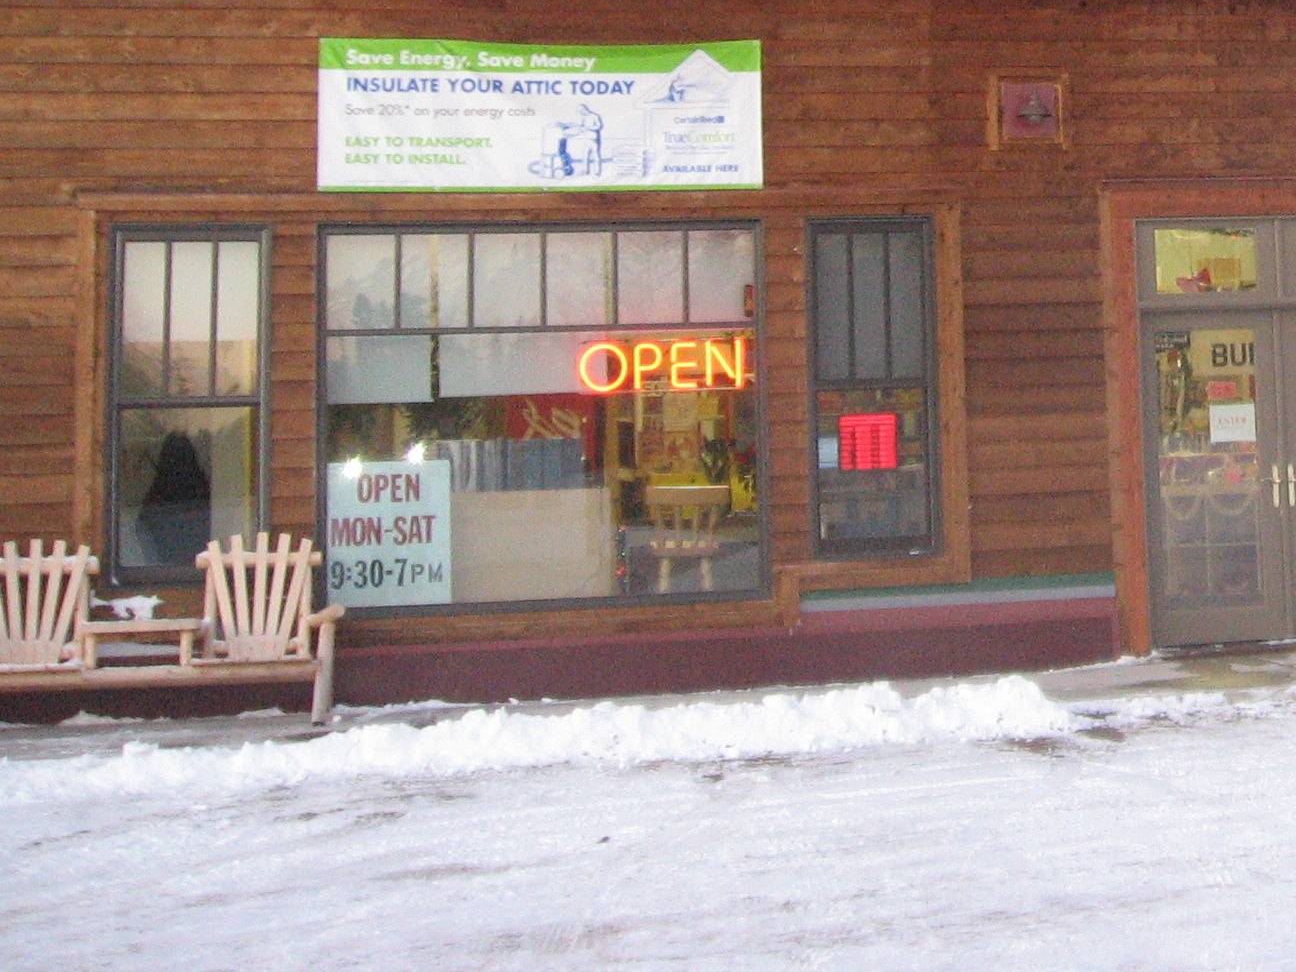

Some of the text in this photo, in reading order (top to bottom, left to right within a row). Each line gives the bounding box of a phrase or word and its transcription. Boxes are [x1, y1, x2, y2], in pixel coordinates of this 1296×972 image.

[345, 49, 394, 66] Save
[477, 51, 524, 68] Save
[530, 54, 597, 71] Money
[346, 77, 635, 95] INSULATE YOUR ATTIC TODAY
[345, 104, 374, 117] Save
[433, 108, 461, 119] your
[464, 108, 503, 120] energy
[507, 107, 536, 117] costs
[345, 136, 380, 148] EASY
[386, 137, 404, 148] TO
[345, 153, 380, 165] EASY
[386, 154, 404, 165] TO
[662, 164, 712, 173] AVAILABLE
[578, 337, 745, 393] OPEN
[357, 473, 421, 503] OPEN
[330, 515, 435, 547] MON-SAT
[410, 563, 443, 584] PM
